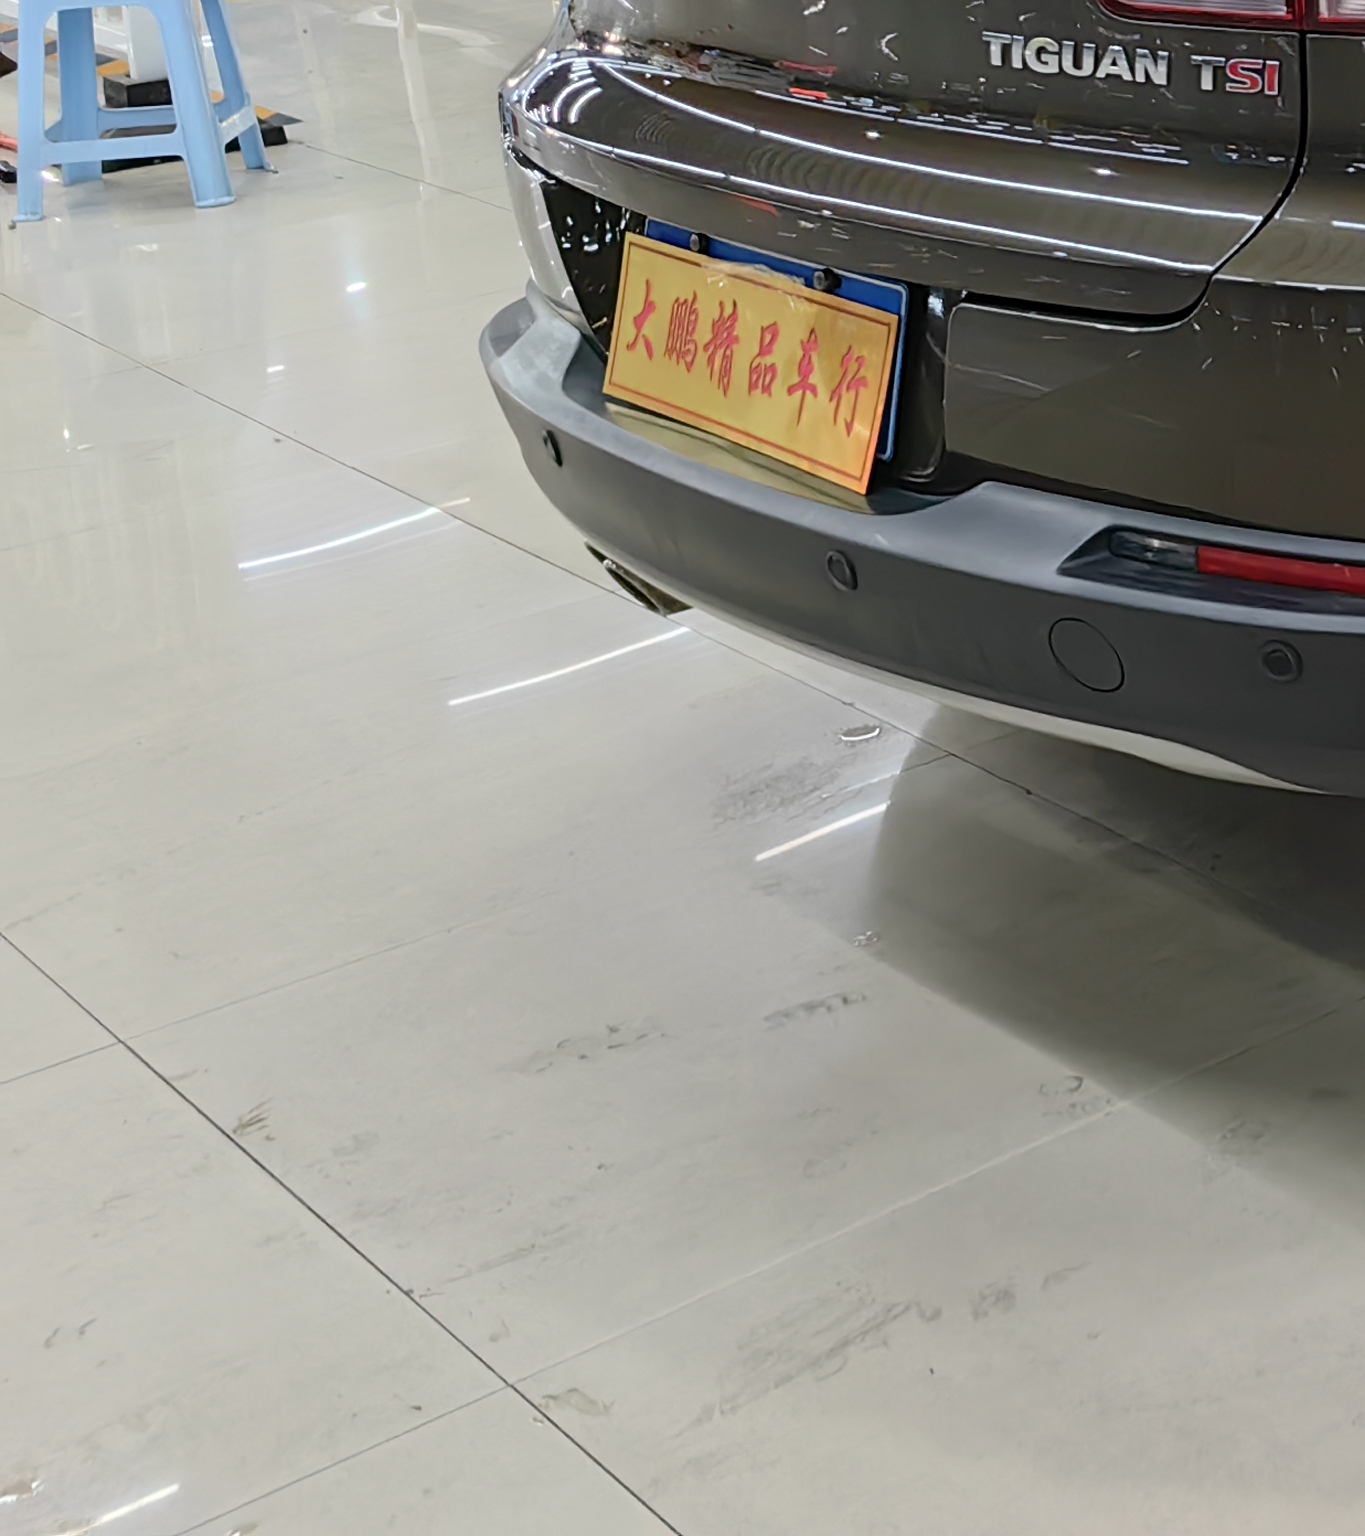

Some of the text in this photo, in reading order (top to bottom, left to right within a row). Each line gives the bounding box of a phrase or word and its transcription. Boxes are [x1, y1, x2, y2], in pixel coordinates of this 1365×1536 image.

[981, 30, 1280, 95] TIGUAN TSI
[626, 278, 869, 438] 大鹏精品车行
